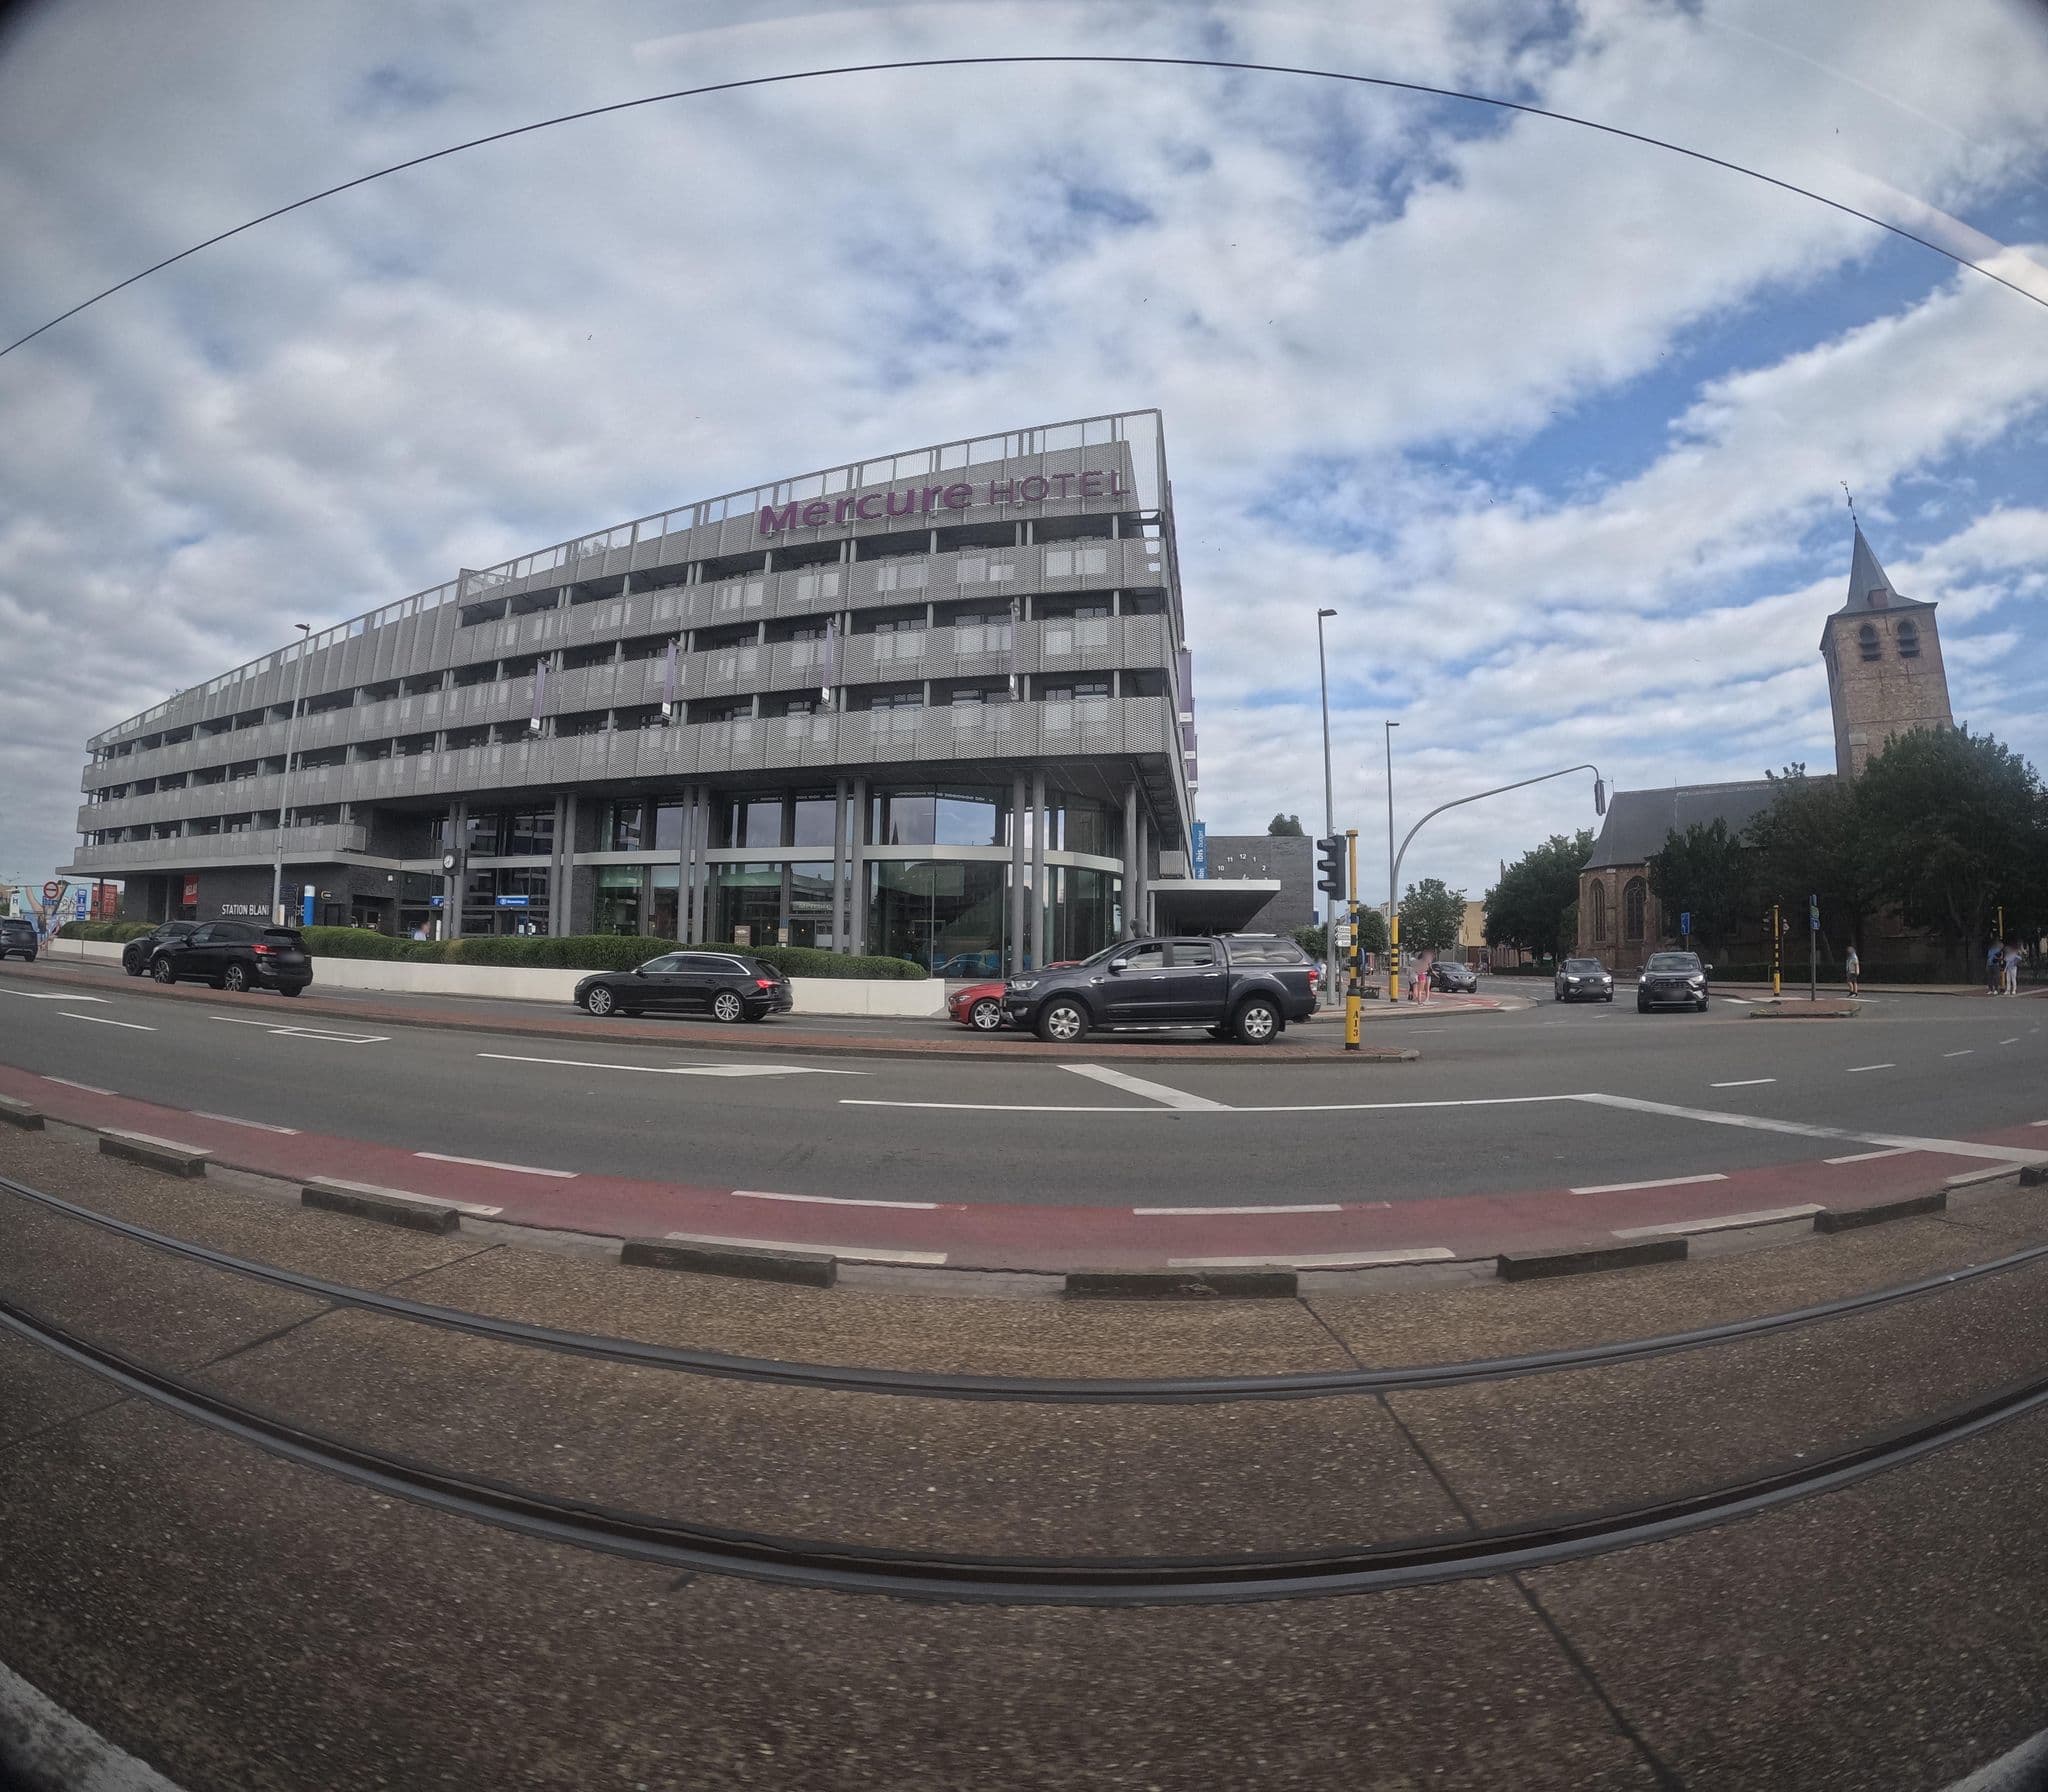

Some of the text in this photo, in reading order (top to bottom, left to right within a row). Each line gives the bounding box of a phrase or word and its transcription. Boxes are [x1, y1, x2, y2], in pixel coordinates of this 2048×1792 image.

[760, 470, 1130, 534] Mercure HOTEL
[1196, 849, 1204, 862] ibis
[221, 904, 248, 915] STATION
